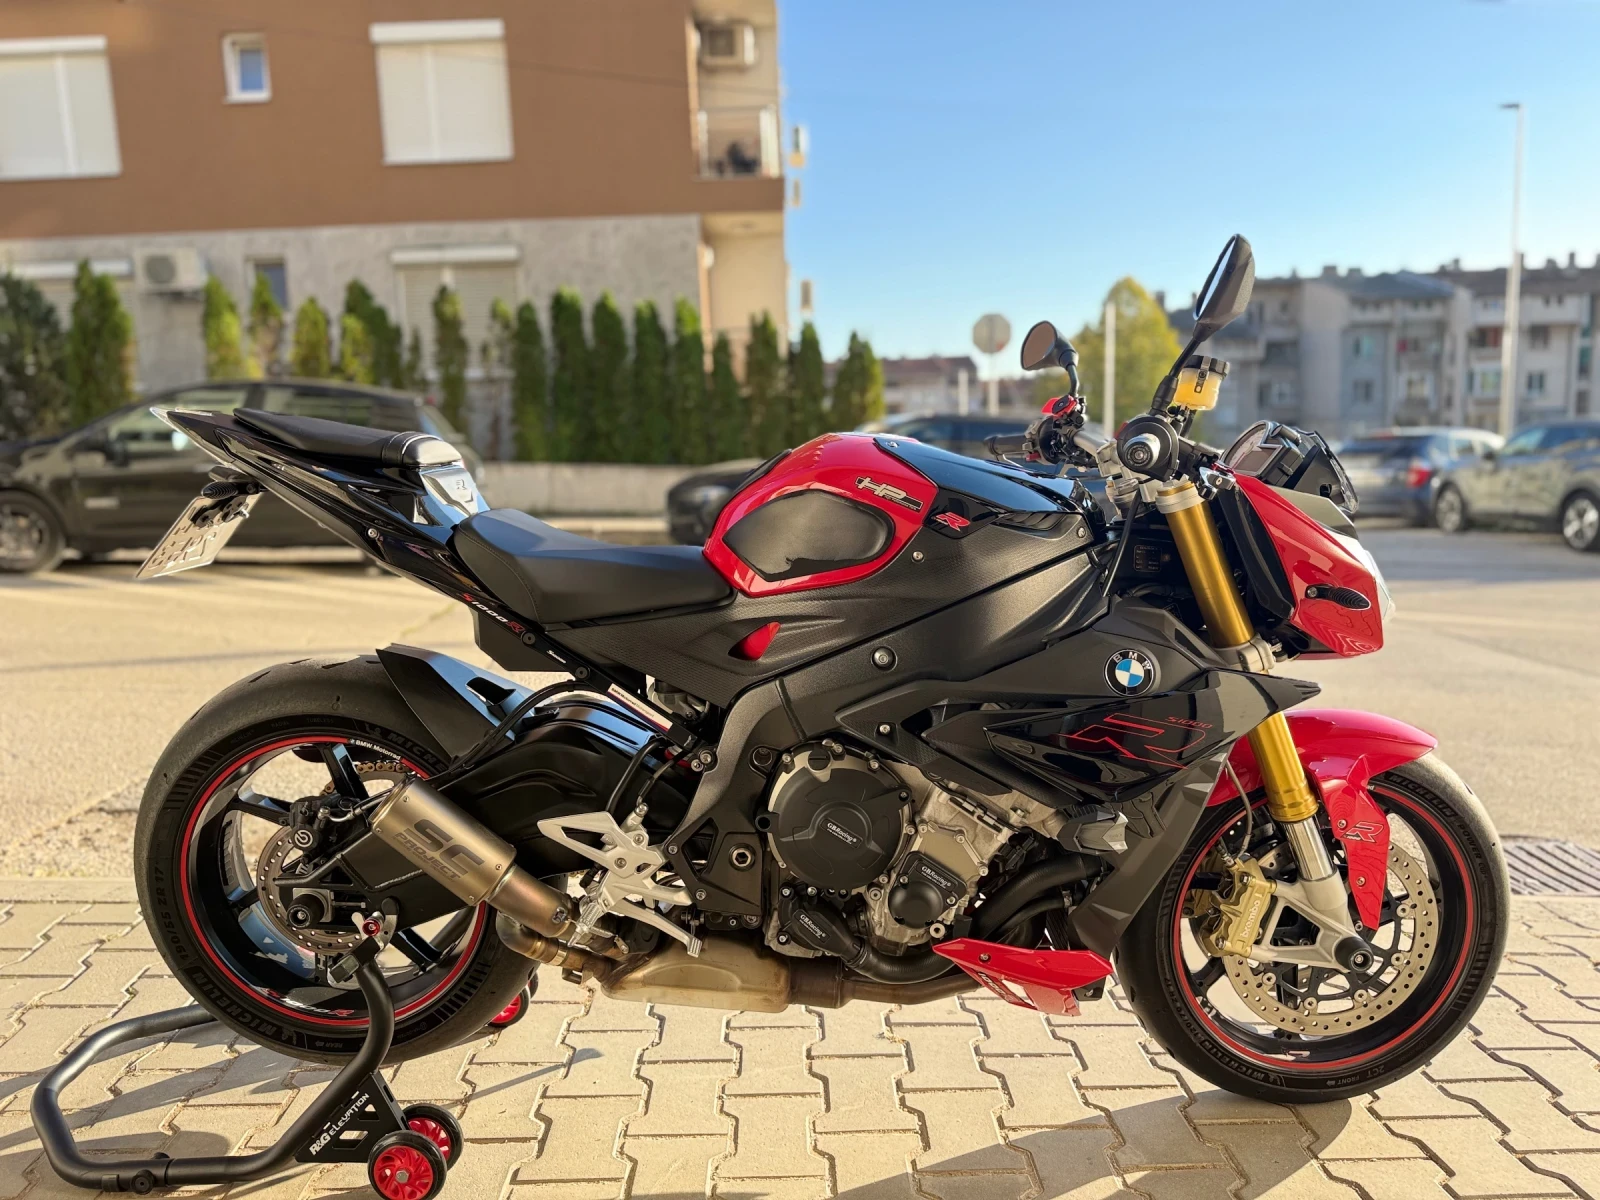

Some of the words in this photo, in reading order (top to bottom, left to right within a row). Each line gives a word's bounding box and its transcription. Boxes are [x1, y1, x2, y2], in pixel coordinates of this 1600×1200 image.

[857, 476, 907, 500] HP
[1113, 651, 1152, 671] BMW
[1165, 716, 1213, 729] S1000
[355, 739, 373, 749] BMW
[373, 745, 402, 760] Motorrad
[387, 732, 449, 772] MICHE
[1346, 822, 1384, 842] R
[1388, 773, 1456, 817] MICHELIN
[1458, 823, 1482, 860] POWER
[392, 832, 462, 879] PROJECT
[403, 818, 486, 876] SC
[155, 887, 168, 906] ZR
[1241, 901, 1260, 938] brembo
[161, 911, 189, 961] 190/55
[191, 970, 279, 1036] MICHELIN
[1167, 991, 1179, 1006] ZR
[1175, 1006, 1200, 1037] 120/70
[1202, 1040, 1265, 1081] MICHELIN
[1366, 1066, 1385, 1079] 2CT
[1337, 1075, 1360, 1086] FRONT
[308, 1131, 332, 1156] R&G
[328, 1092, 370, 1136] ELEVATION
